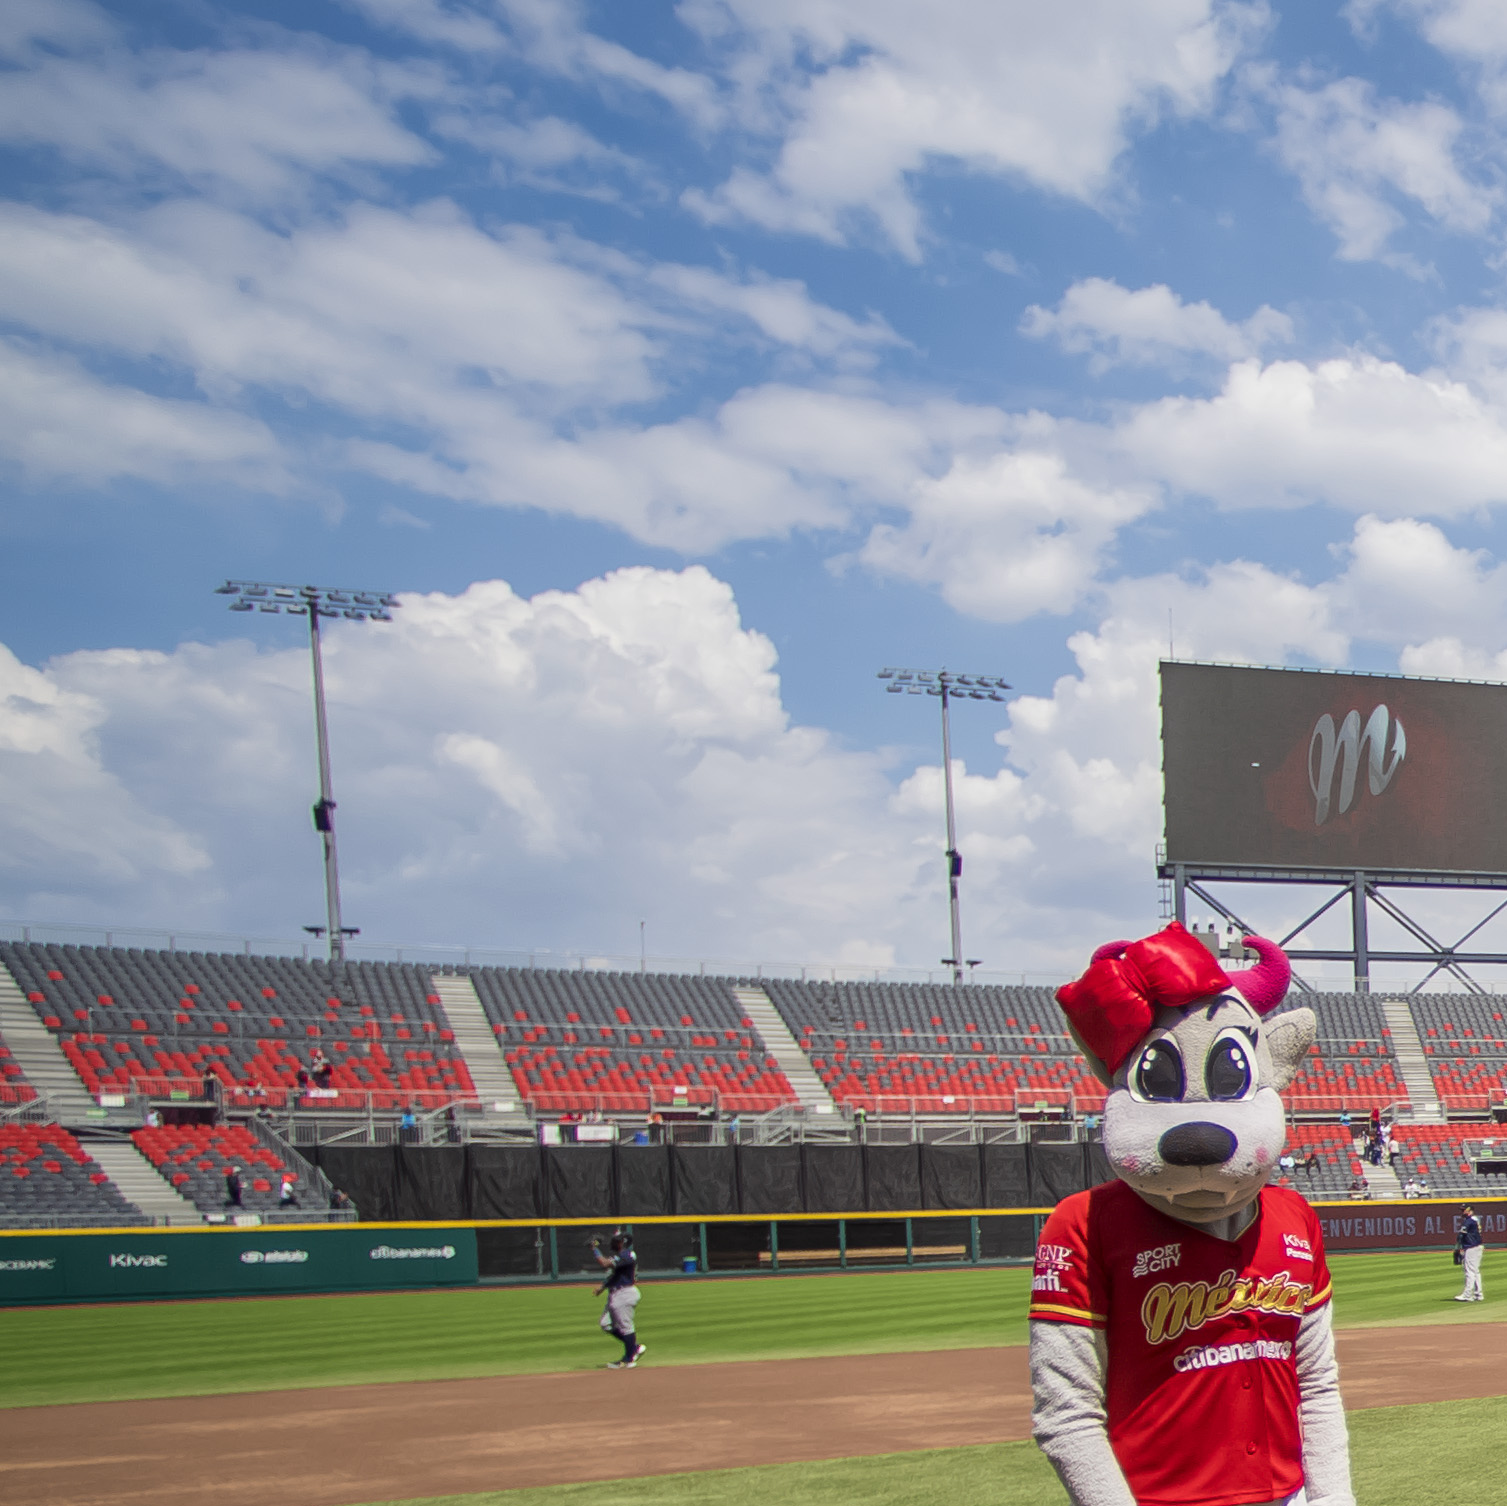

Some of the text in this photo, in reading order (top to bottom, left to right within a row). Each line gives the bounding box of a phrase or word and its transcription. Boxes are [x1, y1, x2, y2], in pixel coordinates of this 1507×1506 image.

[1424, 1216, 1445, 1234] AL
[110, 1253, 167, 1267] Kivac
[1038, 1244, 1072, 1262] GNP
[1136, 1243, 1181, 1265] SPORT
[1150, 1253, 1181, 1272] CITY
